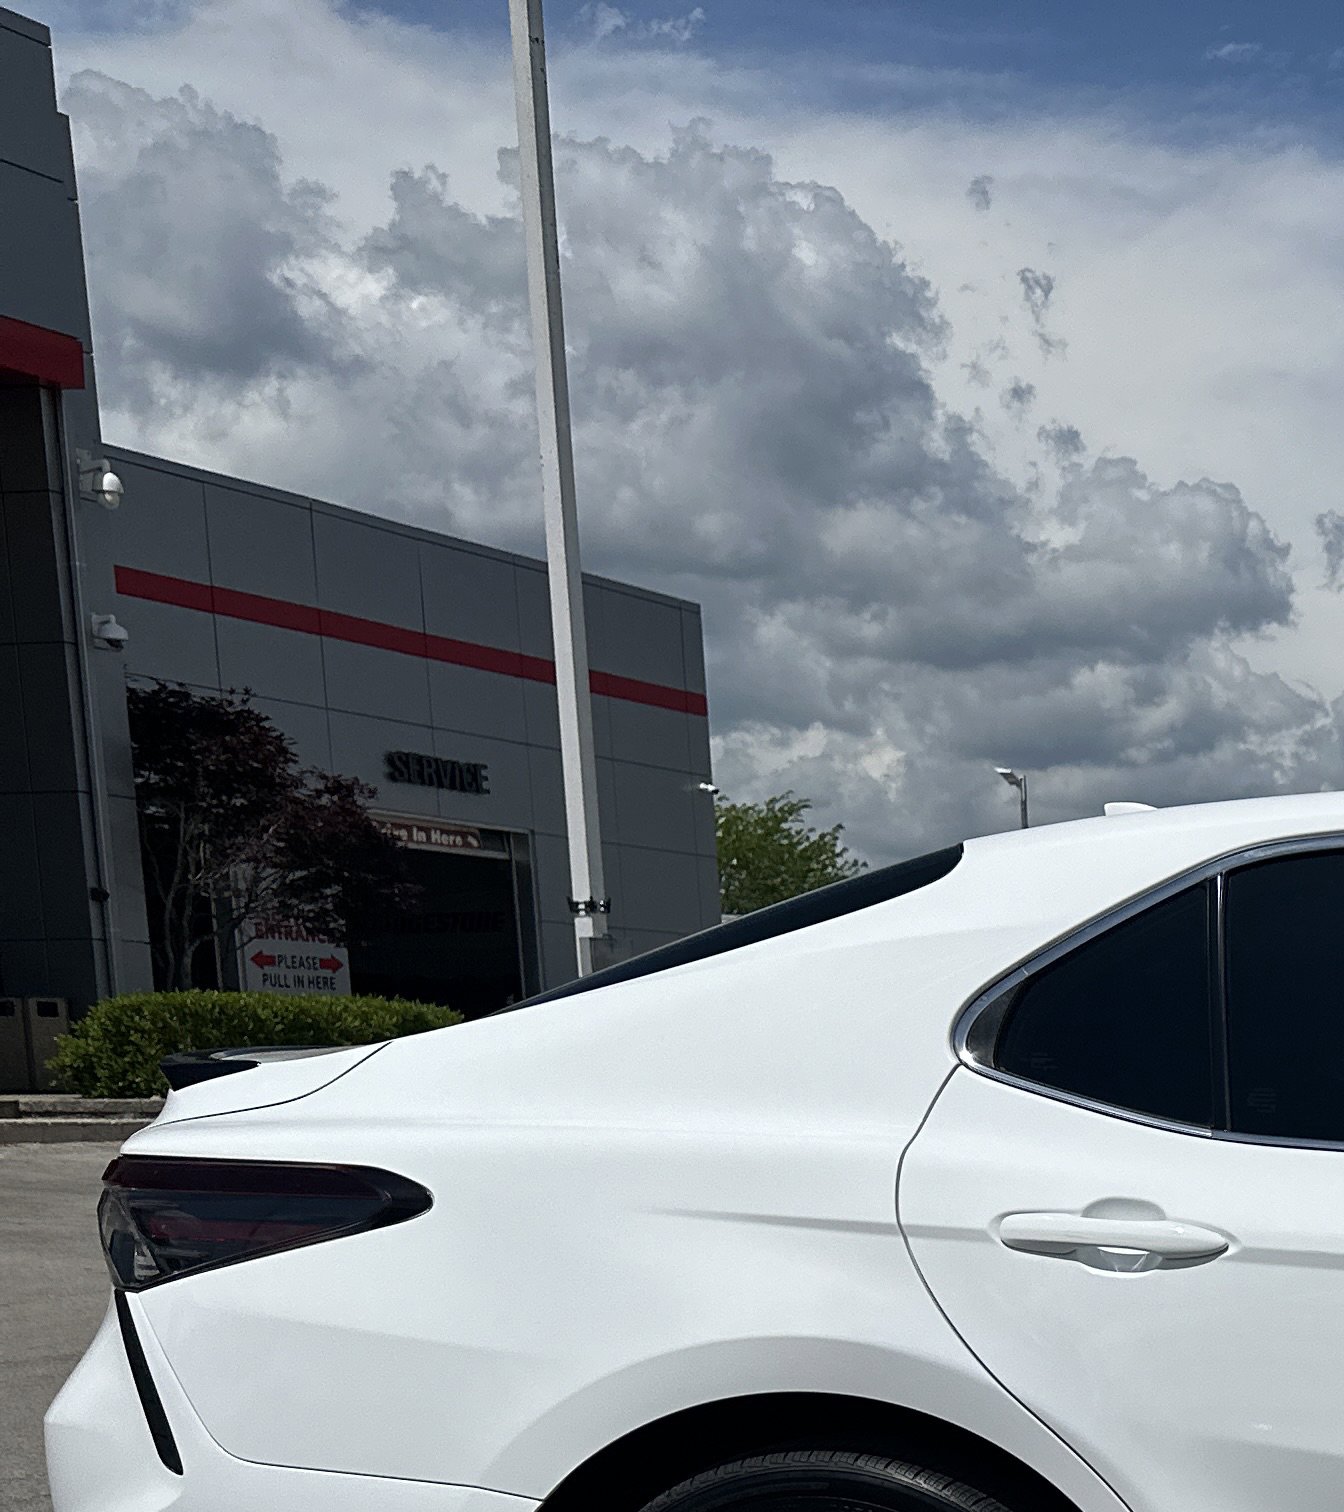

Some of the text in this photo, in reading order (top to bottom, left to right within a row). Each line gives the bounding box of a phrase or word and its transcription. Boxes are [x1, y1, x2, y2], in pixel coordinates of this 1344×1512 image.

[385, 750, 490, 794] SERVICE
[412, 825, 427, 843] In
[430, 828, 463, 846] Here
[277, 953, 319, 971] PLEASE
[262, 972, 337, 991] PULL IN HERE
